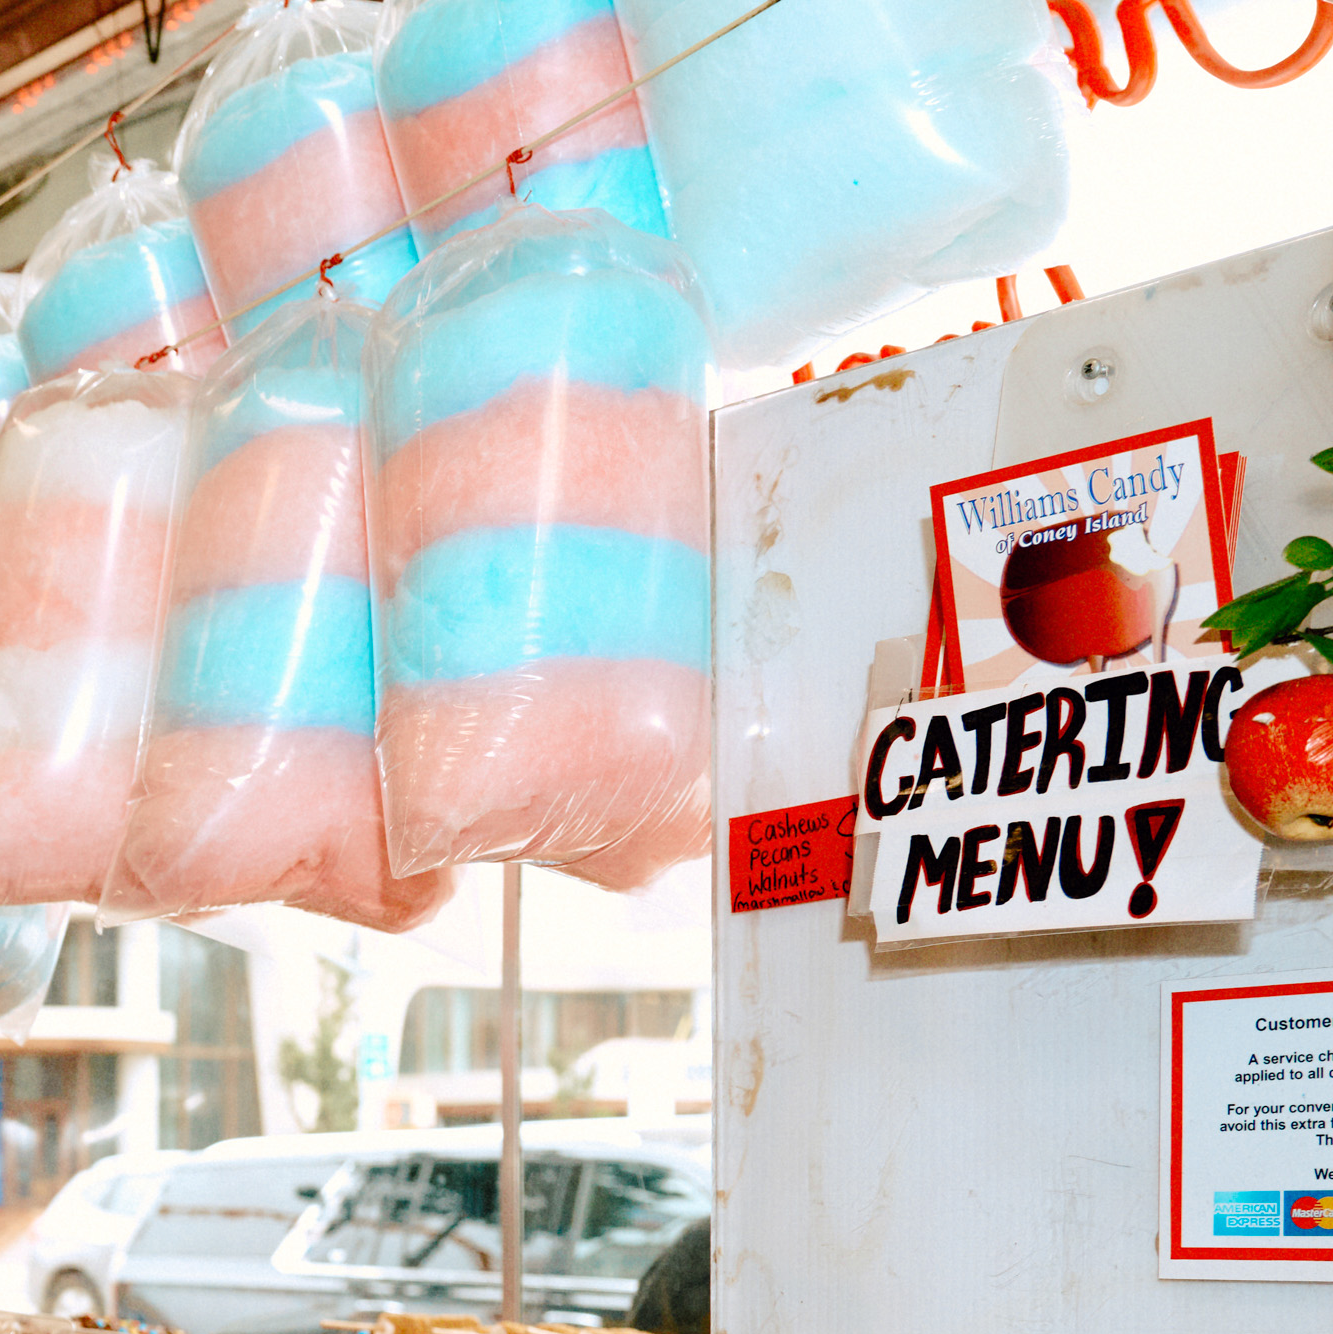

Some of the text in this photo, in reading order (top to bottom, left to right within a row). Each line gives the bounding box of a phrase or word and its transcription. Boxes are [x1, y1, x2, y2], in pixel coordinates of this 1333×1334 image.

[956, 455, 1185, 536] Williams Candy
[996, 502, 1148, 555] of Coney Island
[748, 813, 829, 846] Cashews
[750, 840, 811, 871] Pecans
[749, 863, 819, 897] Walnuts
[1248, 1053, 1259, 1066] A
[1263, 1051, 1314, 1065] service
[1234, 1069, 1285, 1085] applied
[1289, 1068, 1303, 1080] to
[1307, 1066, 1324, 1079] all
[1227, 1103, 1250, 1115] For
[1253, 1104, 1285, 1118] your
[1219, 1118, 1326, 1132] avoid this extra
[1213, 1203, 1277, 1214] AMERICAN
[1227, 1216, 1281, 1228] EXPRESS
